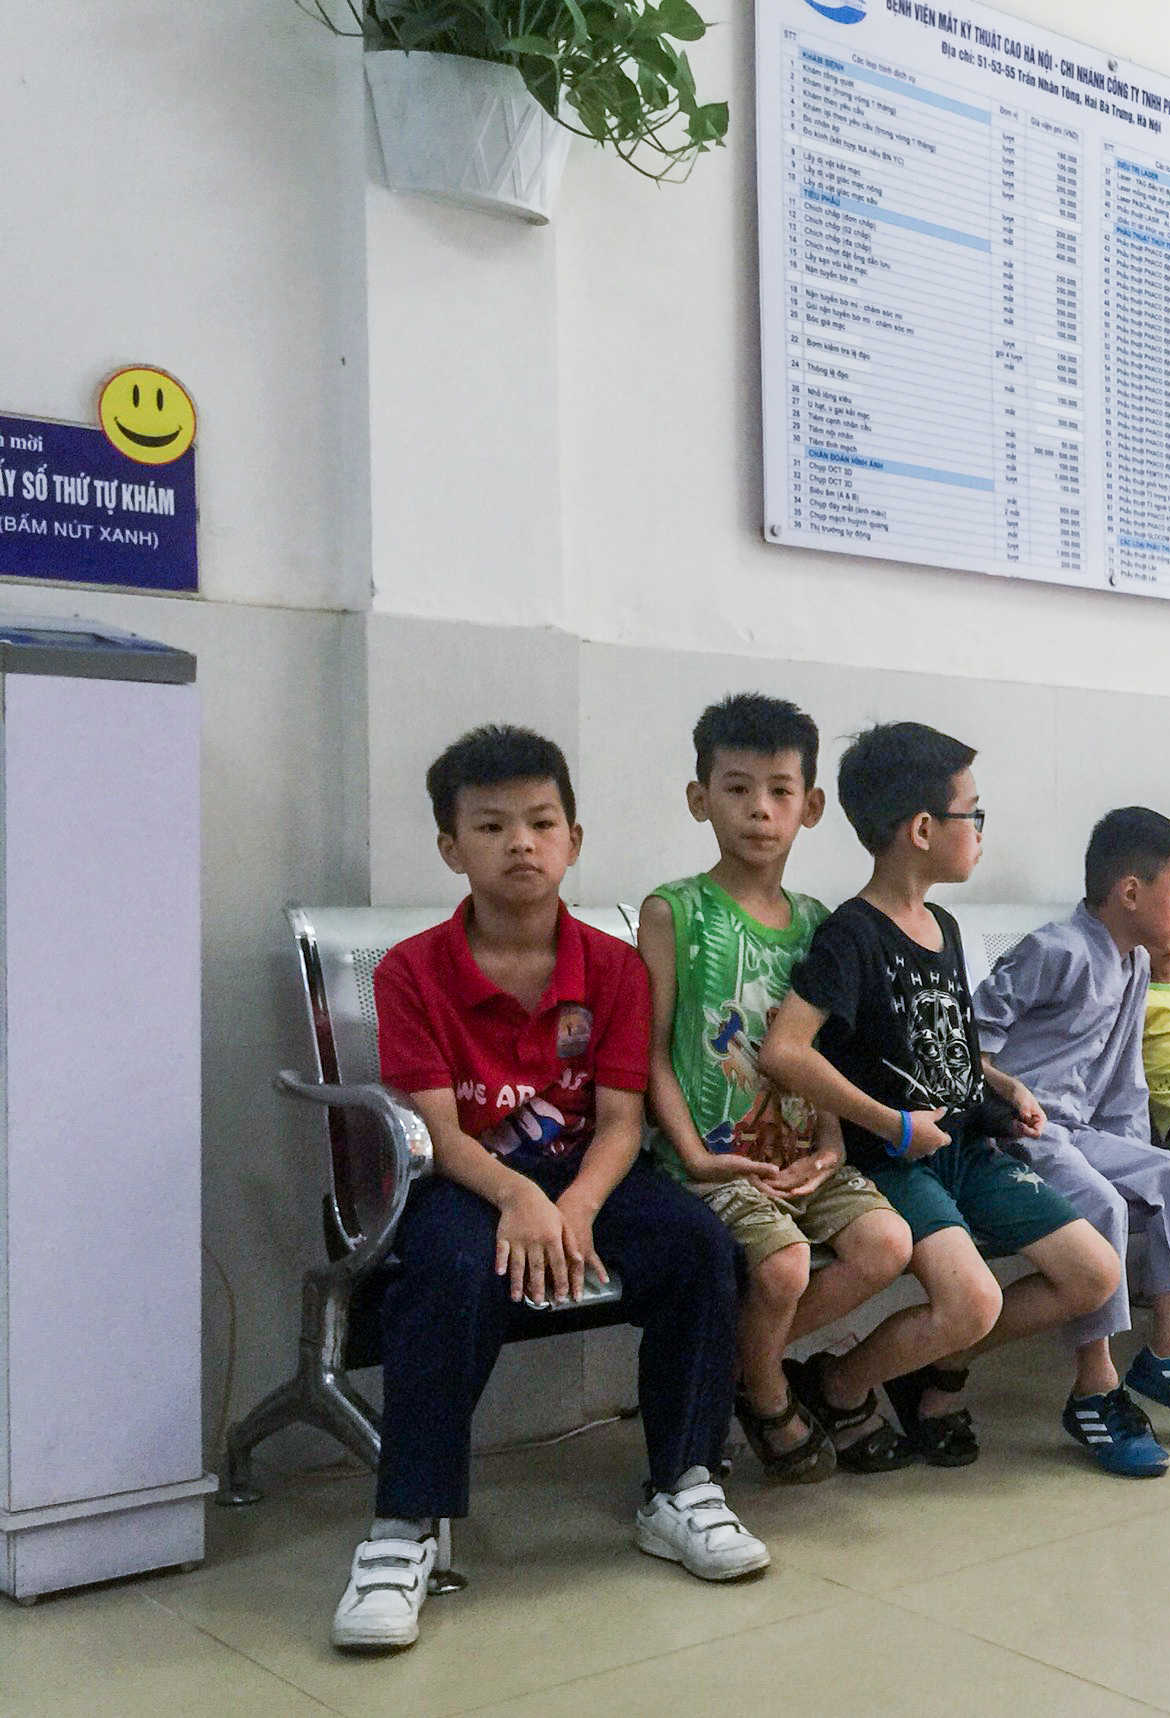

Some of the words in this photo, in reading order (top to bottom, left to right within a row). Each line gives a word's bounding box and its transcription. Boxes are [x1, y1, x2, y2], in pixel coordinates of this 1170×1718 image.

[914, 3, 936, 28] VIỆN
[975, 25, 1002, 54] THUẬT
[1004, 37, 1022, 59] CAO
[1038, 49, 1053, 74] NỘI
[1060, 59, 1075, 79] CHI
[1077, 64, 1105, 90] NHÁNH
[1107, 75, 1128, 99] CÔNG
[1131, 86, 1140, 104] TY
[1142, 90, 1162, 112] TNHH
[977, 54, 1016, 79] 51-53-55
[1018, 69, 1036, 87] Trần
[1038, 77, 1059, 95] Nhân
[1084, 94, 1097, 109] Hai
[1149, 117, 1162, 134] Nội
[11, 436, 43, 452] mời
[22, 464, 48, 502] SỐ
[53, 472, 91, 506] THỨ
[94, 479, 119, 515] TỰ
[122, 481, 175, 516] KHÁM
[54, 519, 93, 540] NÚT
[100, 527, 159, 549] XANH)
[456, 1079, 487, 1106] WE
